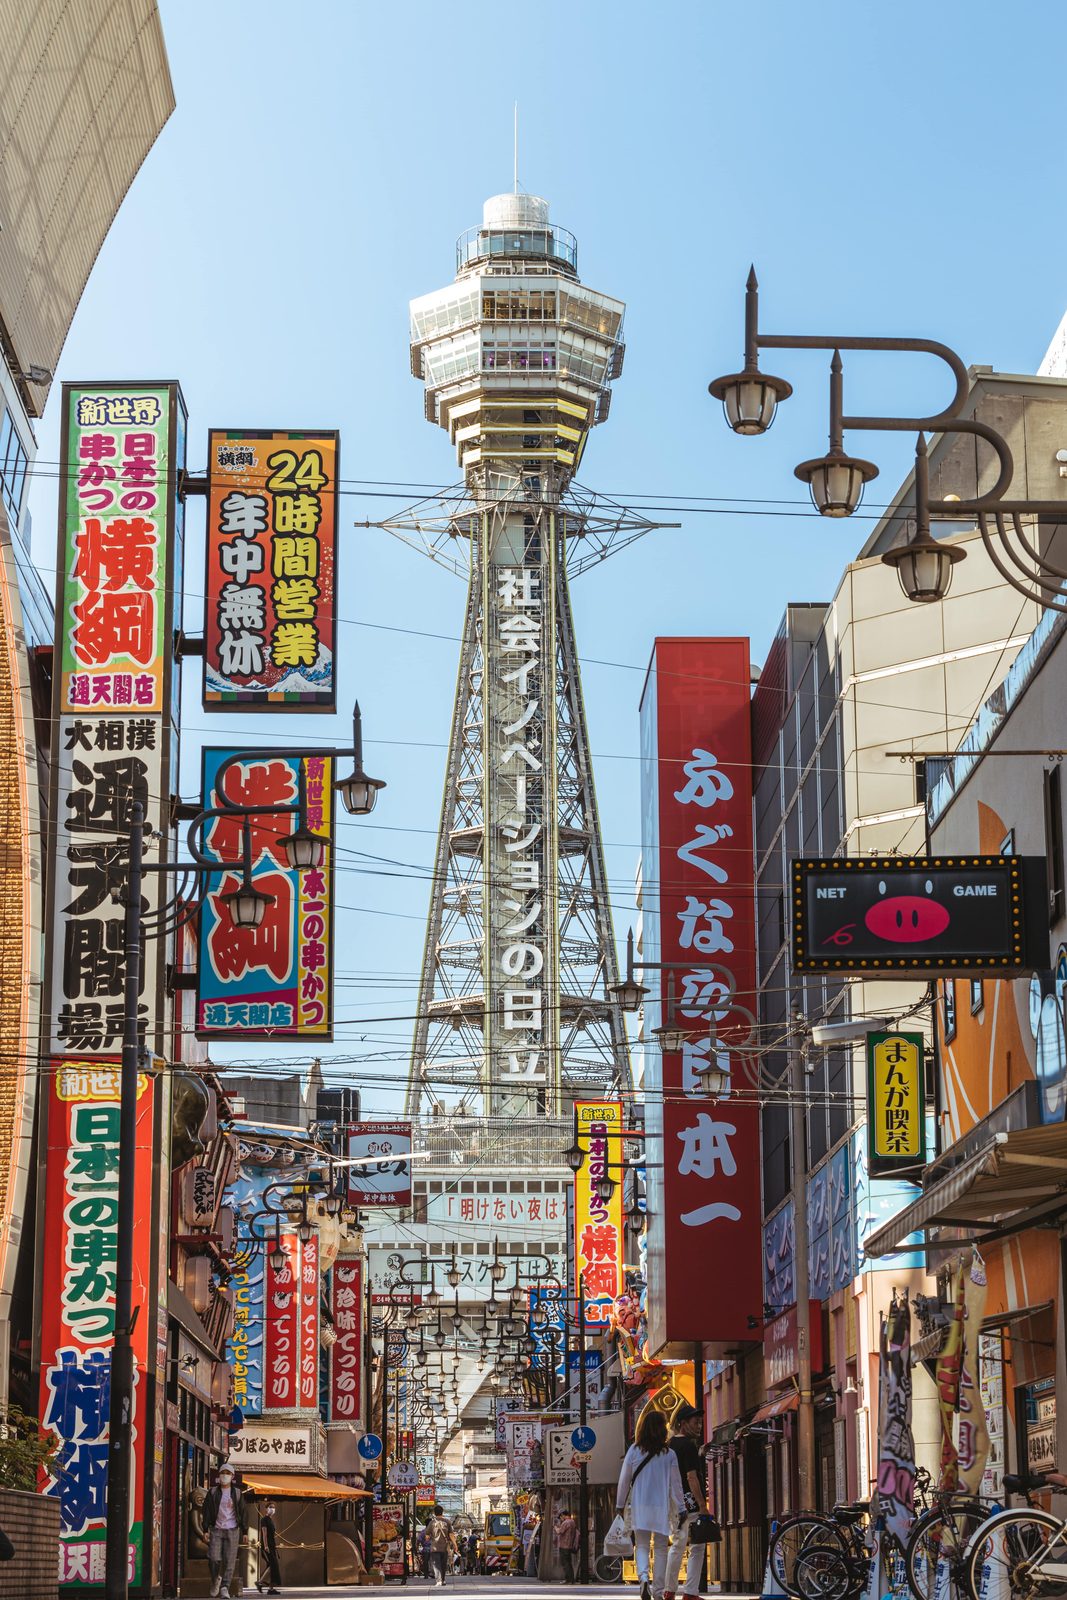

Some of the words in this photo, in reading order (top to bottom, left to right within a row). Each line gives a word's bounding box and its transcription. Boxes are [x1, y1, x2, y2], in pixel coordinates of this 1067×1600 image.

[79, 397, 160, 425] 新世界
[78, 433, 117, 511] 串かつ
[120, 433, 156, 511] 日本一の
[73, 518, 157, 666] 横綱
[220, 493, 267, 676] 年中無休
[269, 449, 327, 667] 24時間営業
[69, 675, 156, 705] 通天閣店
[64, 719, 157, 751] 大相撲
[498, 569, 546, 1081] 社会イノベーションの日立
[60, 756, 153, 999] 通天閣
[207, 762, 298, 986] 横綱
[816, 887, 847, 898] NET
[953, 885, 997, 897] GAME
[302, 843, 327, 1026] 本一の串かつ
[57, 1002, 150, 1051] 場所
[205, 1003, 294, 1027] 通天閣店
[582, 1107, 615, 1121] 新世界
[884, 1042, 910, 1153] まんが喫茶
[363, 1193, 396, 1203] 年中無休
[303, 1243, 316, 1285] 名物
[581, 1224, 617, 1299] 横綱
[272, 1315, 291, 1399] てっちり
[302, 1315, 316, 1399] てっちり
[337, 1286, 358, 1416] 珍味てっちり
[233, 1437, 307, 1455] づぼらや本店
